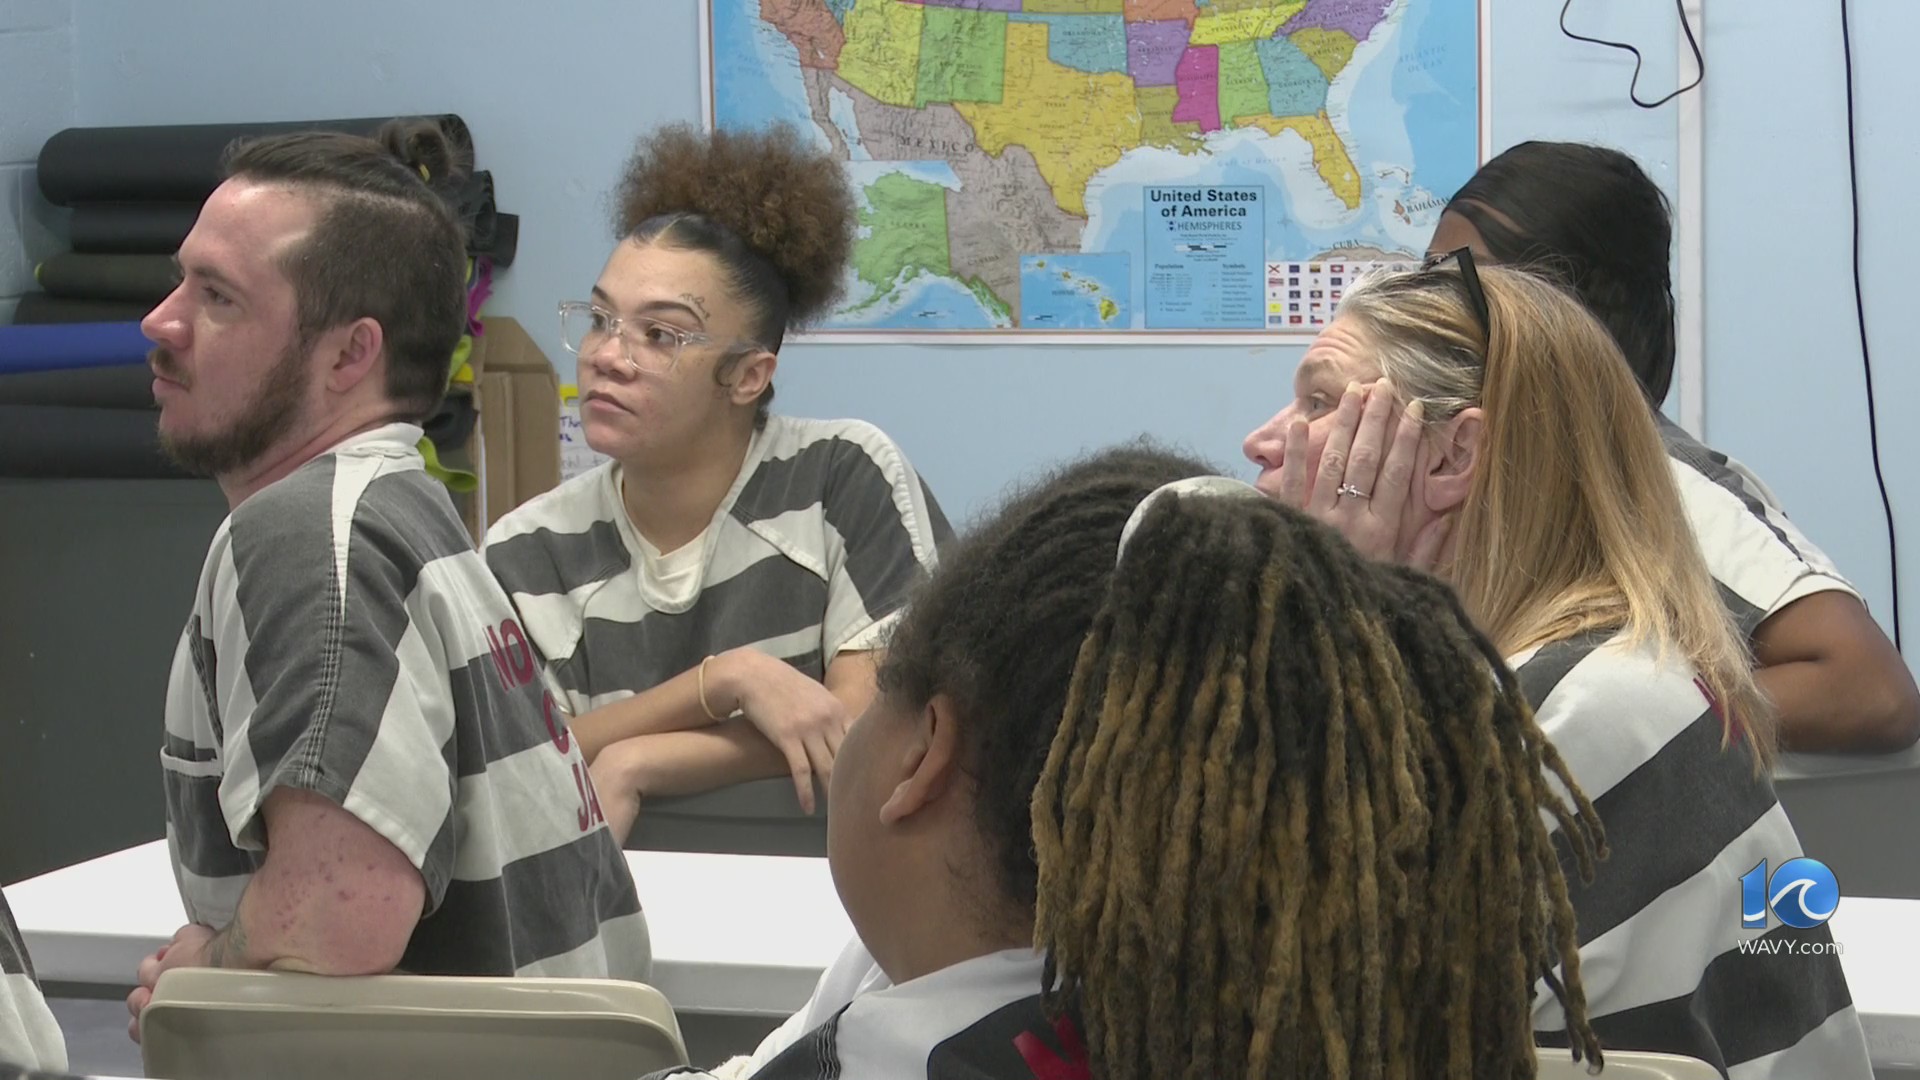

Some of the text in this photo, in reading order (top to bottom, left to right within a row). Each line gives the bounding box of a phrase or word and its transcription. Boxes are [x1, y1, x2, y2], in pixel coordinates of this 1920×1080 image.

[1408, 59, 1443, 73] OCEAN
[901, 136, 975, 152] MEXICO
[1150, 190, 1257, 202] United States
[1161, 205, 1247, 217] of America
[1177, 221, 1242, 231] HEMISPHERES
[1332, 238, 1360, 250] CUBA
